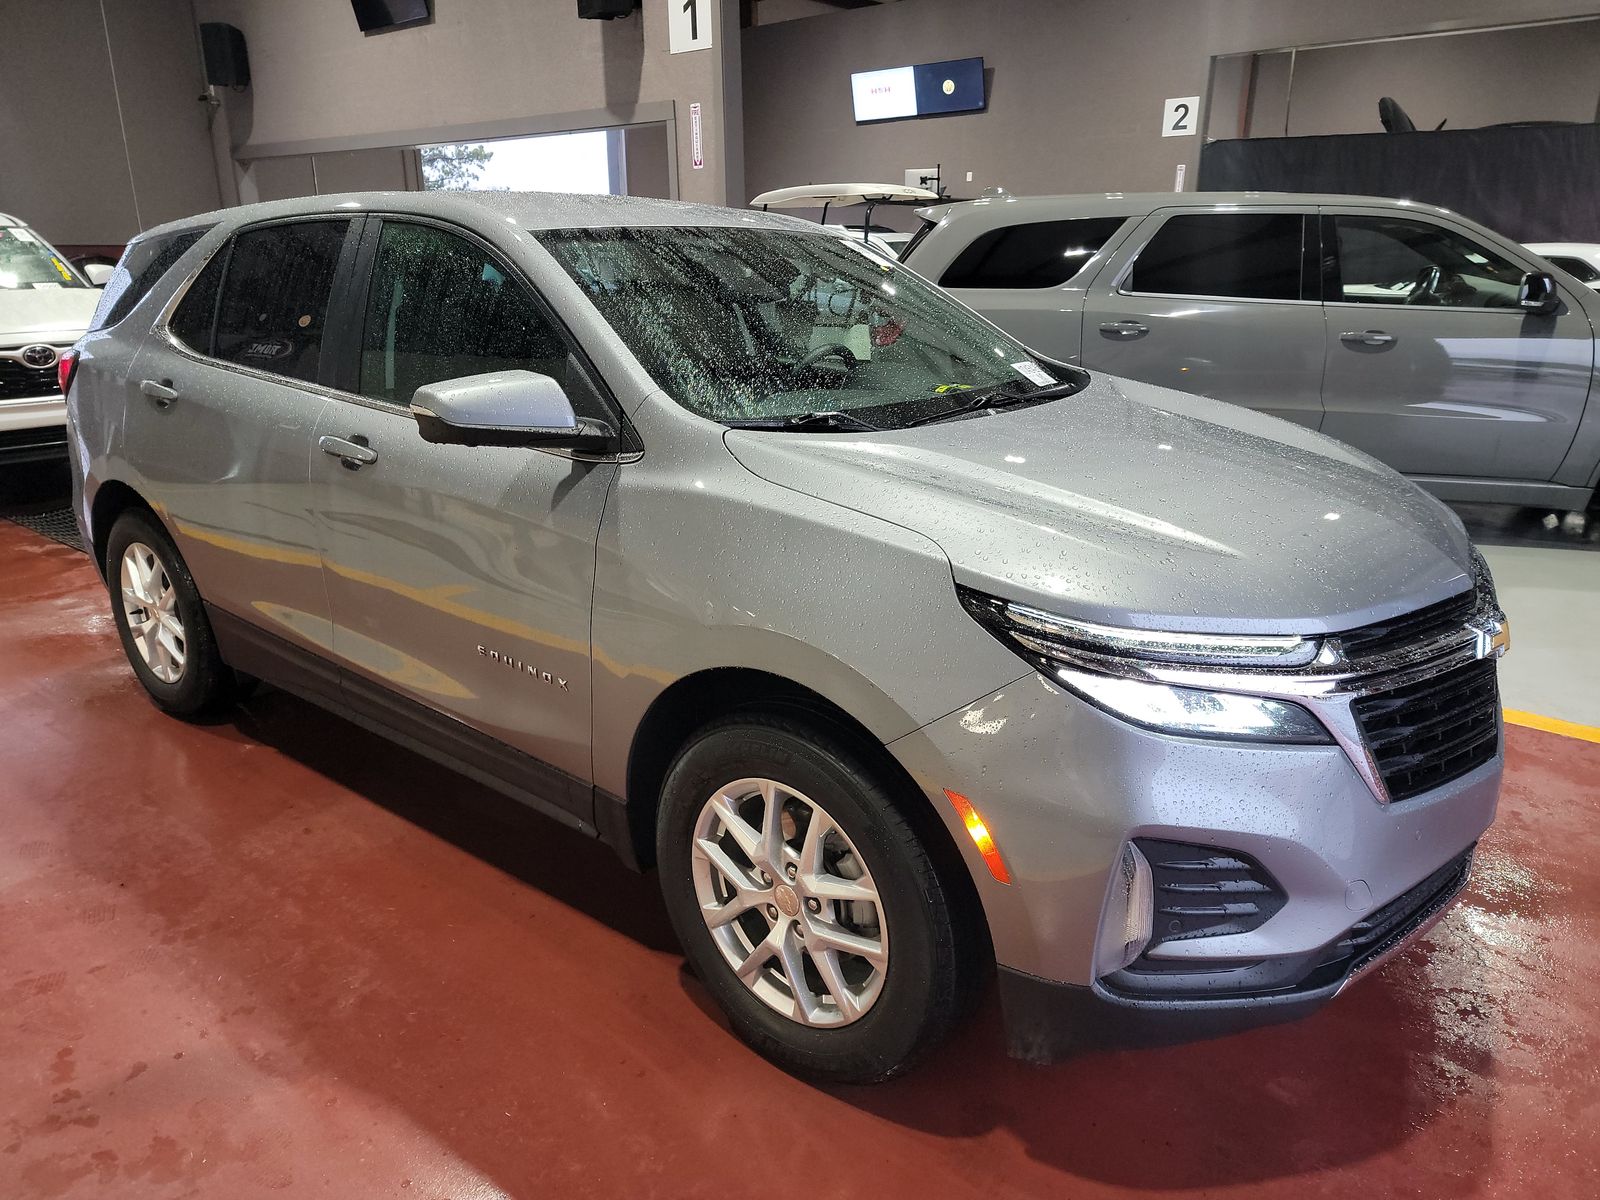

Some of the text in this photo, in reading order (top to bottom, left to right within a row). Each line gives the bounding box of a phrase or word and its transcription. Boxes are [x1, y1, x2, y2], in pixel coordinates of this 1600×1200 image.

[683, 0, 698, 40] 1
[1172, 103, 1189, 130] 2
[477, 644, 569, 693] EQUINOX
